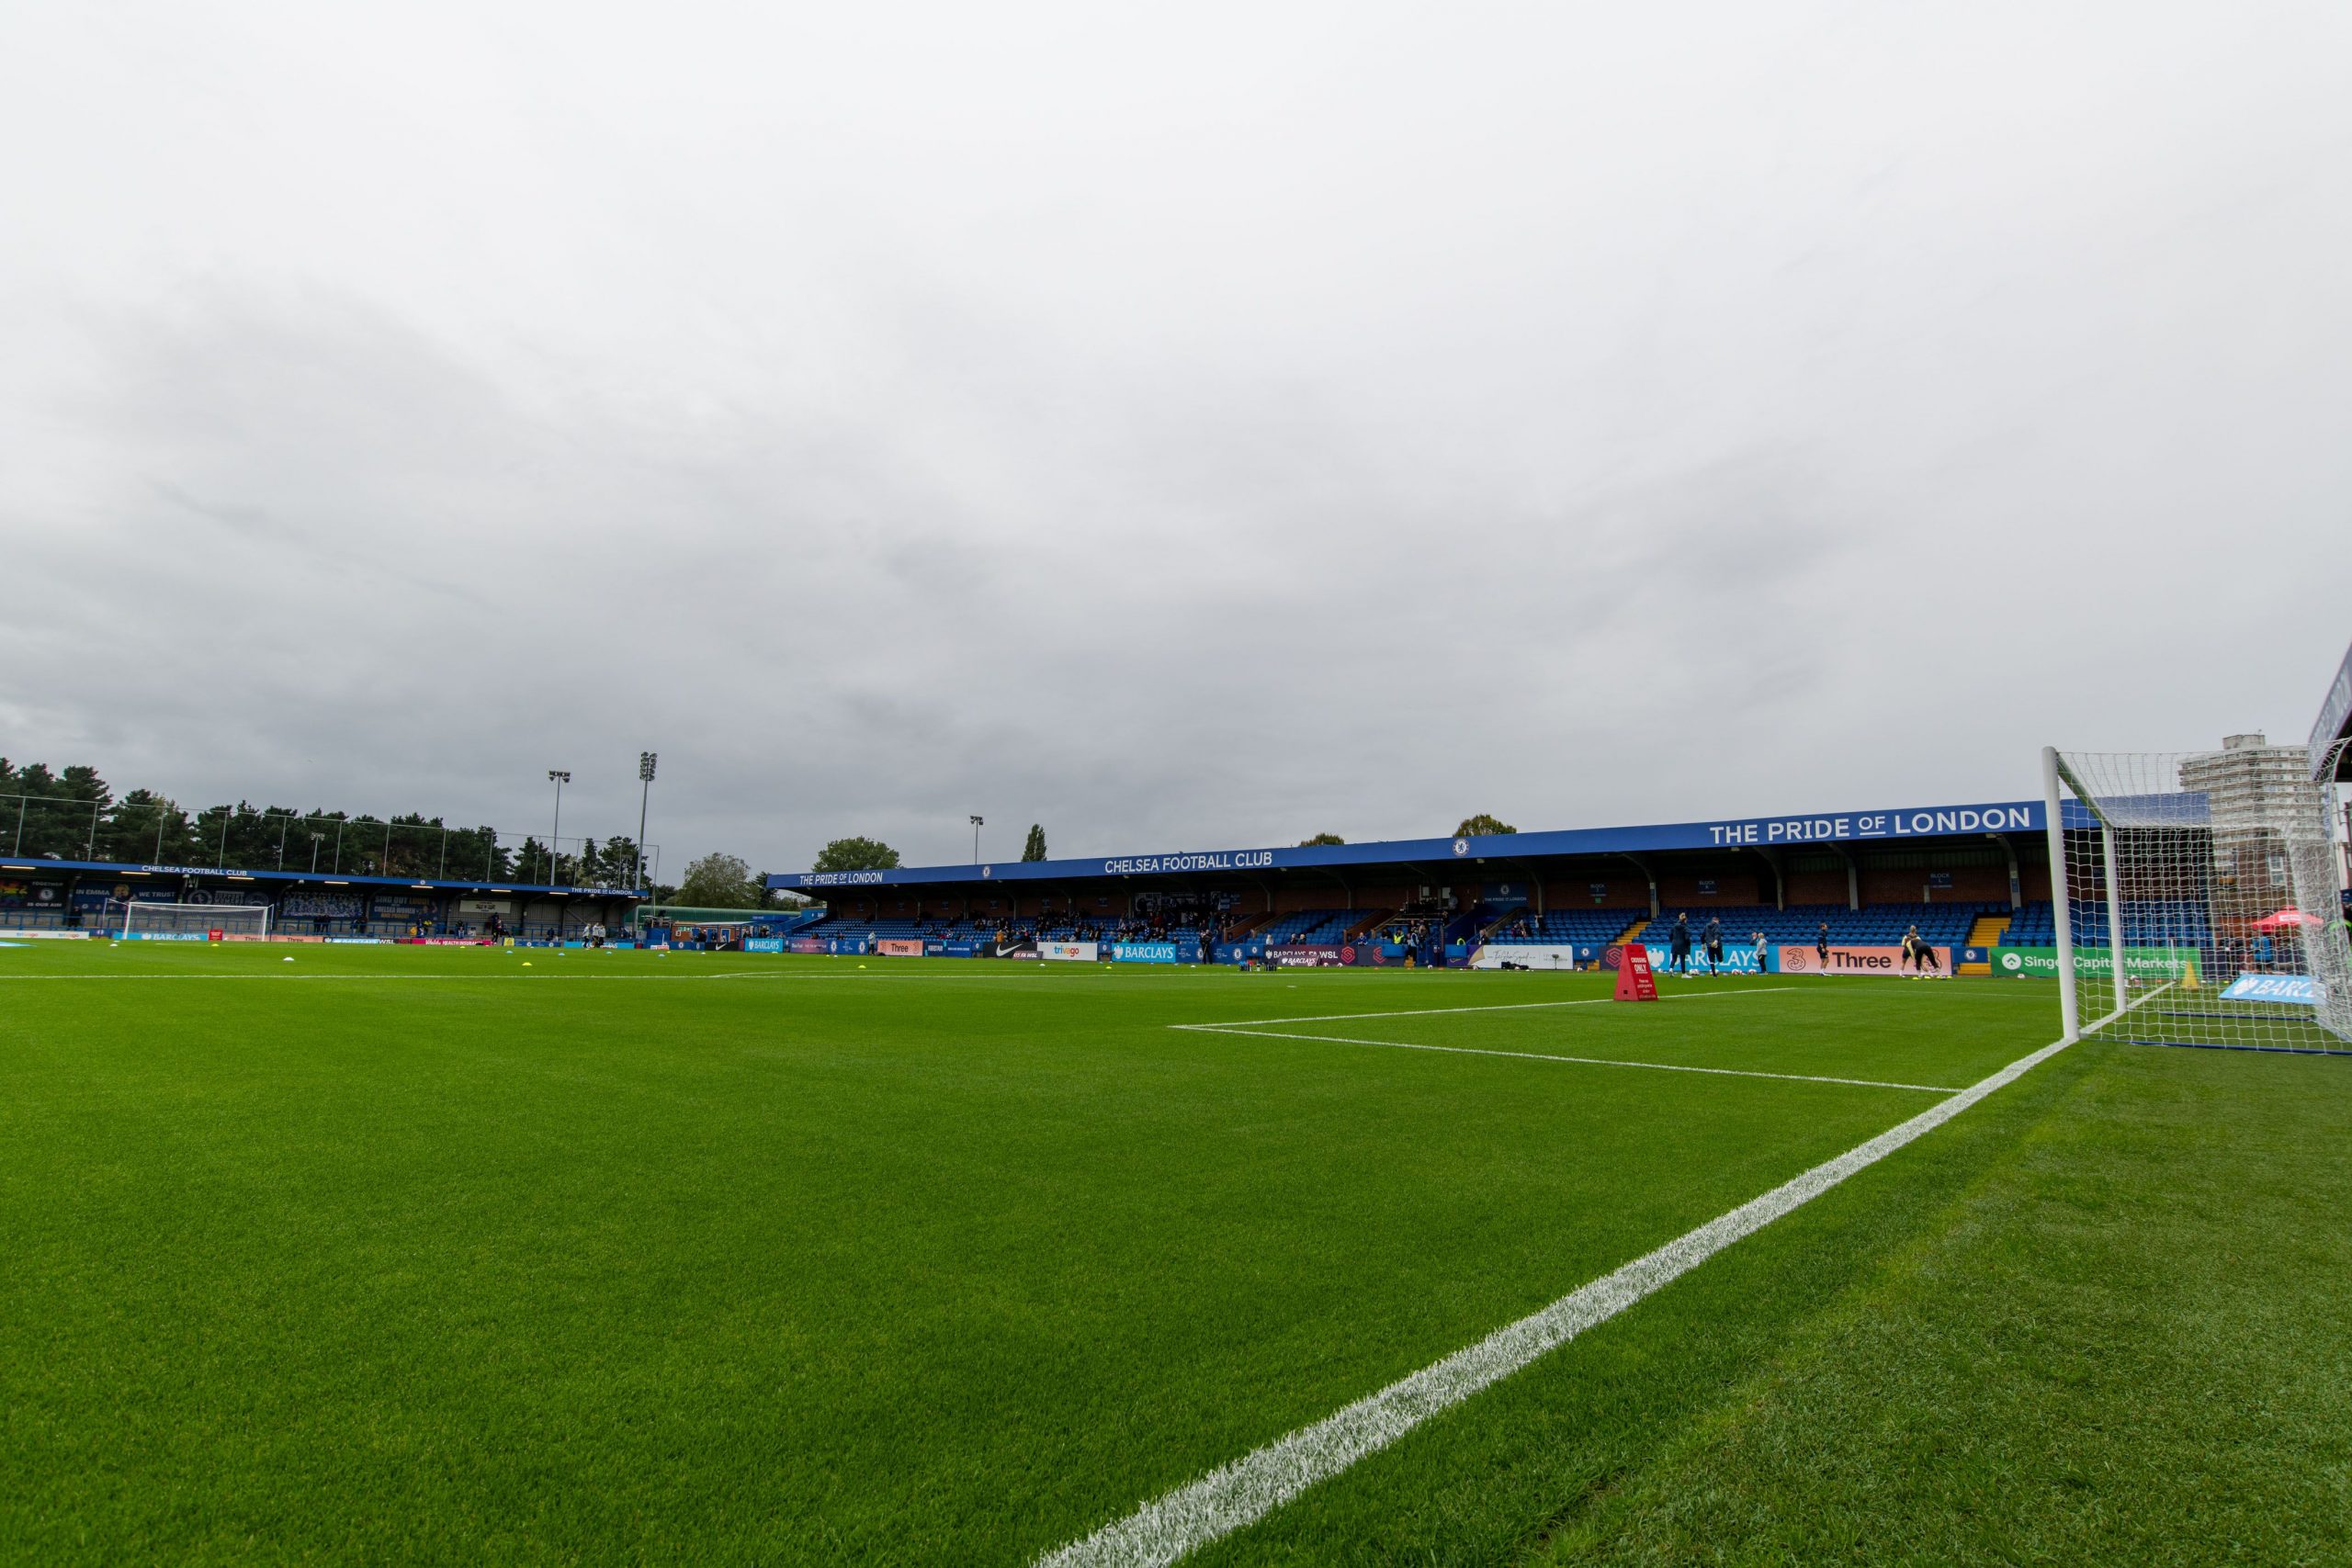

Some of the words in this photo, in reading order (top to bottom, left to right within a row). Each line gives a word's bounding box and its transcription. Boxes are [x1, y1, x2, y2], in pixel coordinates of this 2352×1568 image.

[1710, 824, 1758, 844] THE
[1768, 818, 1849, 841] PRIDE
[1858, 816, 1885, 833] OF
[1894, 807, 2030, 834] LONDON
[1104, 858, 1159, 874] CHELSEA
[1162, 854, 1231, 871] FOOTBALL
[1235, 852, 1272, 866] CLUB
[182, 867, 224, 875] FOOTBALL
[799, 874, 814, 886] THE
[814, 874, 838, 885] PRIDE
[839, 874, 847, 882] OF
[848, 872, 883, 884] LONDON
[753, 941, 779, 950] BARCLAYS
[891, 943, 909, 953] Three
[1054, 945, 1080, 957] trivago
[1125, 946, 1174, 959] BARCLAYS
[1318, 951, 1339, 959] WSL
[1832, 952, 1892, 968] Three
[2024, 956, 2059, 970] Singe
[2127, 957, 2188, 969] Markets
[1634, 964, 1647, 972] ONLY
